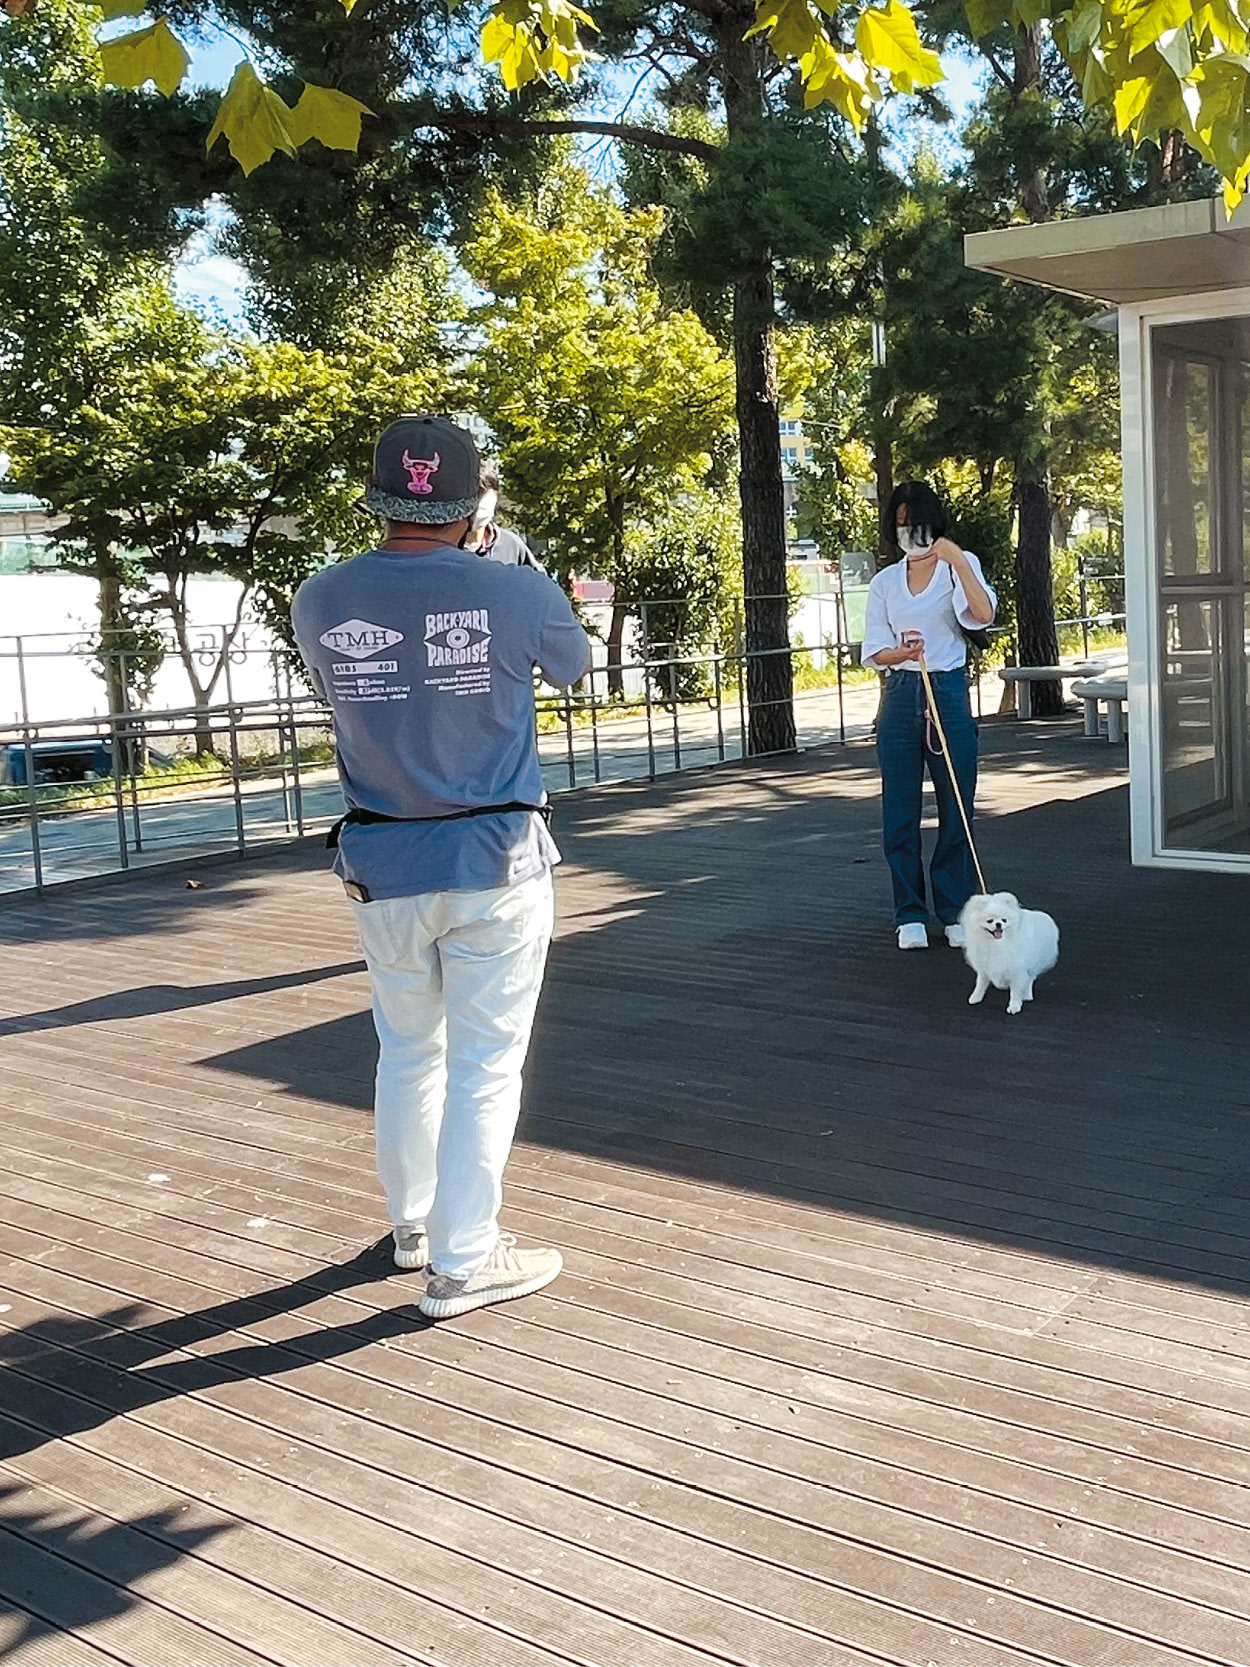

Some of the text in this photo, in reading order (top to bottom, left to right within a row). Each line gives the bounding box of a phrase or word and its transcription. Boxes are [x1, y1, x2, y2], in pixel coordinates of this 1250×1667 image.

[424, 609, 492, 640] BACKYARD
[326, 630, 390, 648] TMH
[424, 636, 492, 667] PARADISE
[377, 662, 395, 671] 401
